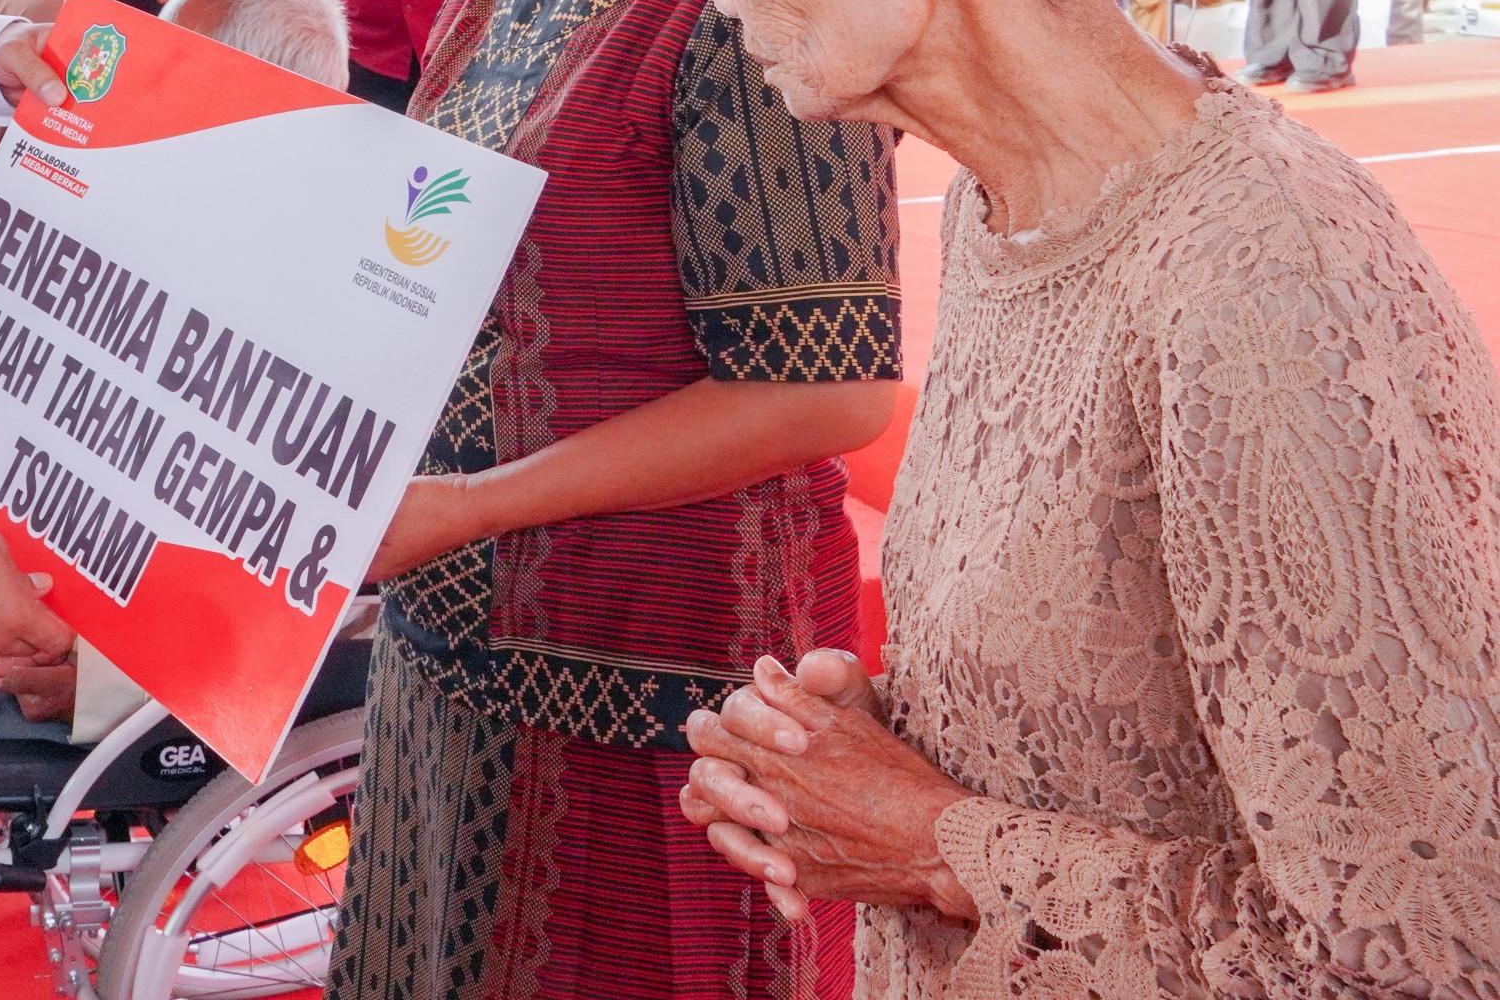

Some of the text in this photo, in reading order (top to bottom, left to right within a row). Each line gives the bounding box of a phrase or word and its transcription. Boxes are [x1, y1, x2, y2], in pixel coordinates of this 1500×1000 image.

[42, 116, 89, 146] KOTA MEDAN
[21, 156, 88, 196] MEDAN BERKAH
[352, 273, 430, 319] REPUBLIK INDONESIA
[358, 257, 437, 304] KEMENTERIAN SOSIAL
[156, 307, 397, 510] BANTUAN
[43, 354, 166, 482] TAHAN
[153, 431, 297, 580] GEMPA
[289, 524, 337, 609] &
[160, 745, 206, 767] GEA
